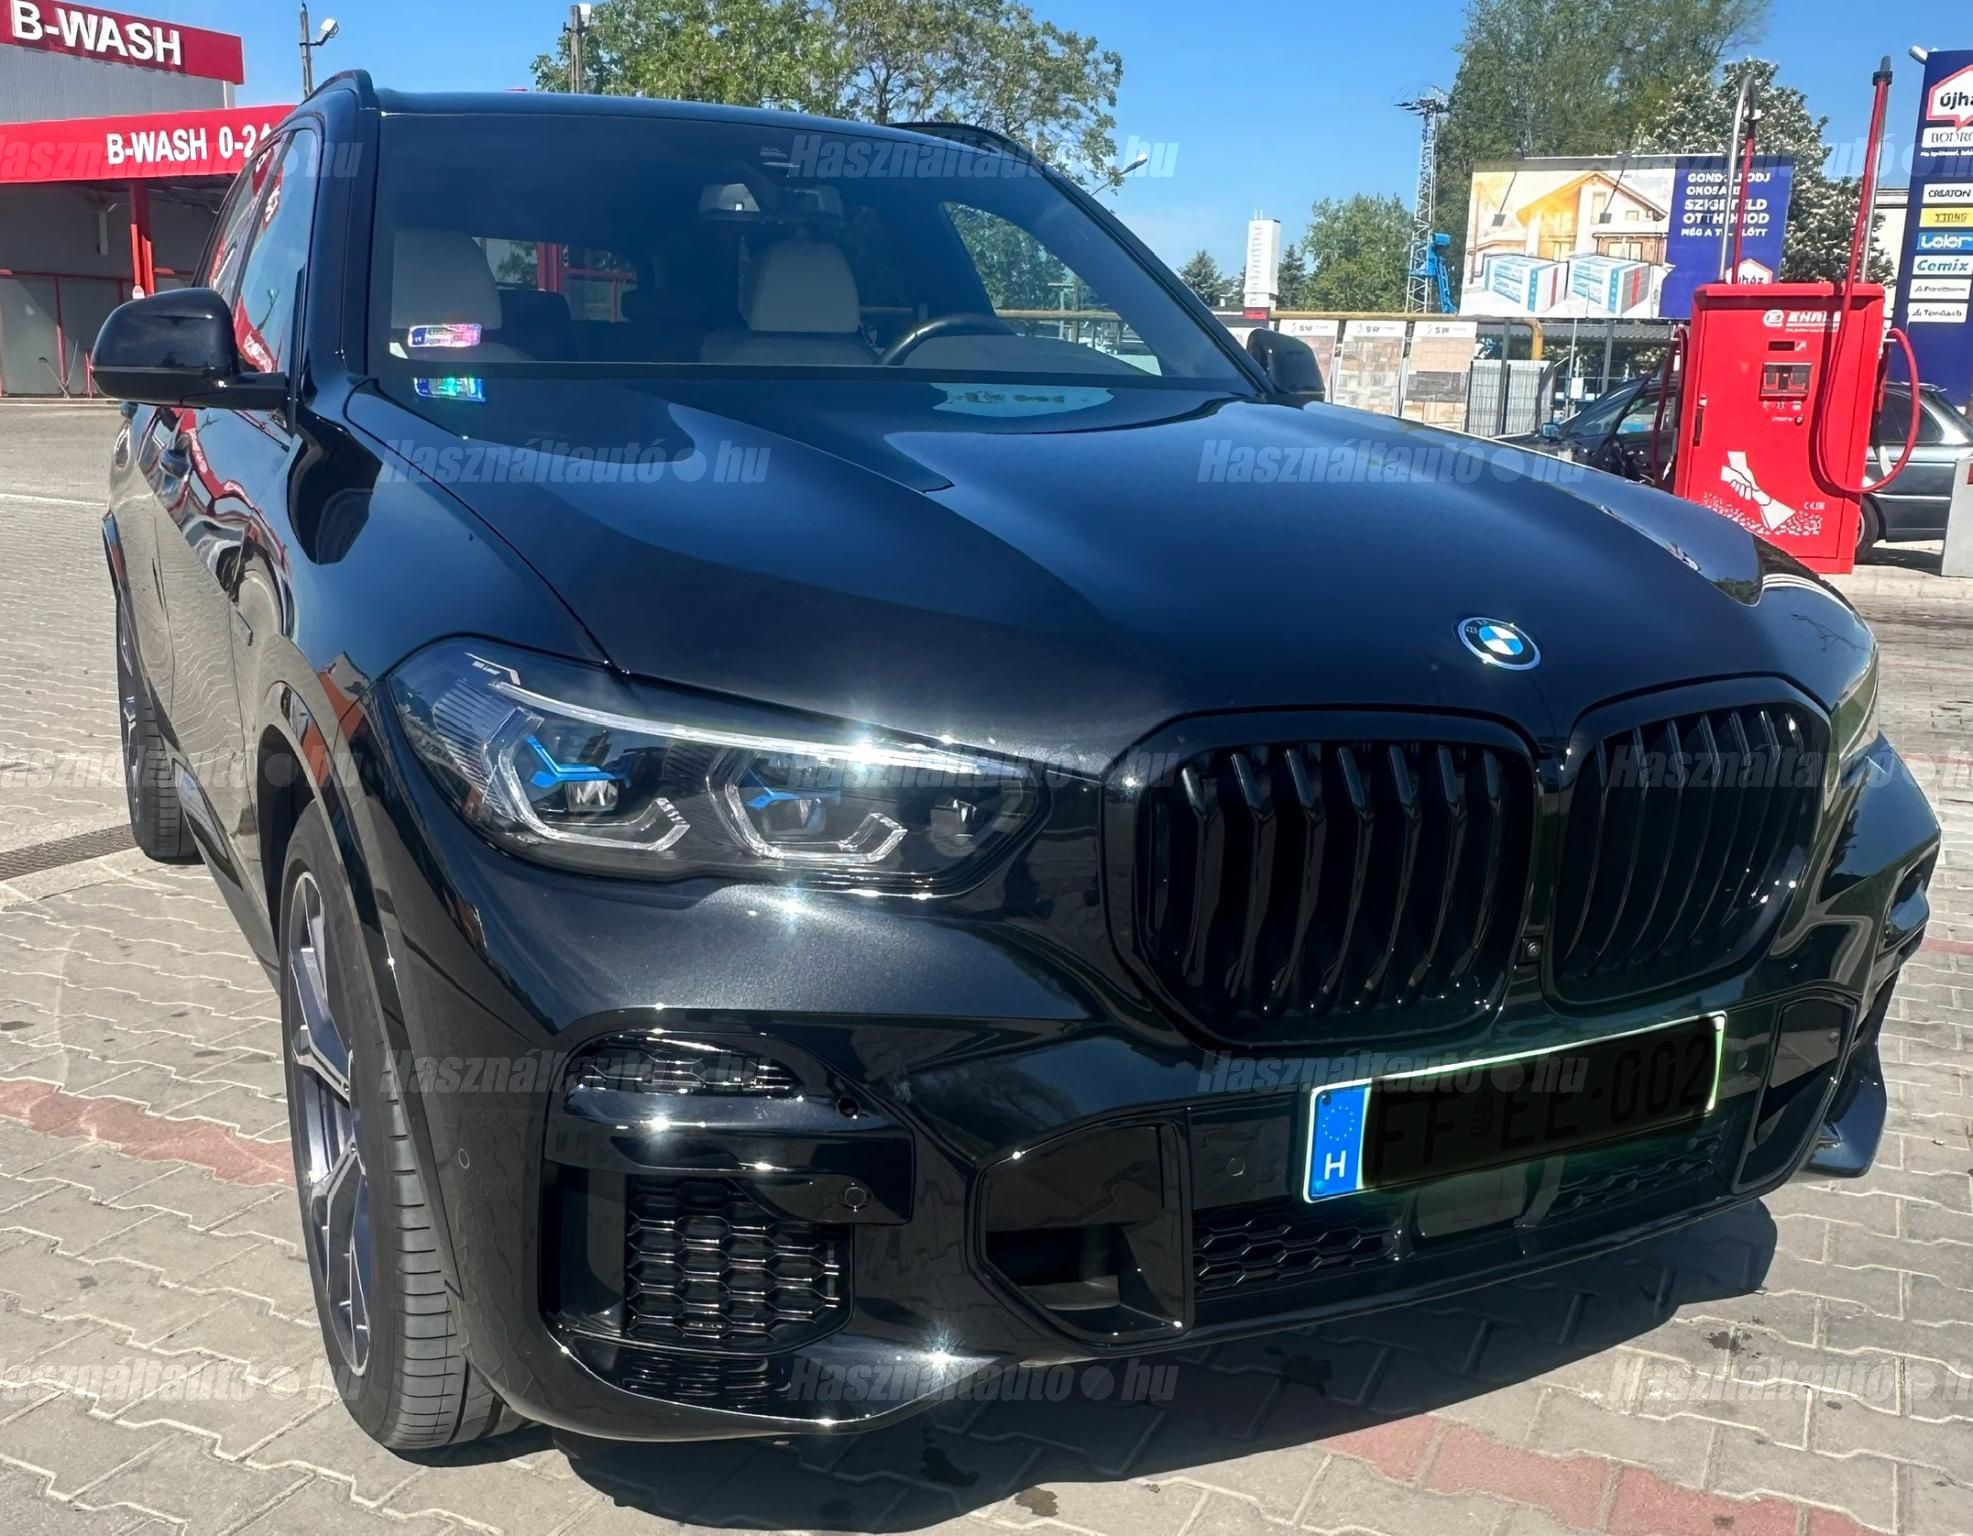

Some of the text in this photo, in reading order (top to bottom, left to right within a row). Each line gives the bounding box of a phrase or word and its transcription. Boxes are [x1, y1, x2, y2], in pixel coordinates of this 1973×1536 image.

[12, 0, 183, 66] B-WASH
[1940, 91, 1973, 110] újh
[106, 127, 207, 164] B-WASH
[1917, 259, 1969, 272] Cemix
[1324, 1150, 1346, 1180] H
